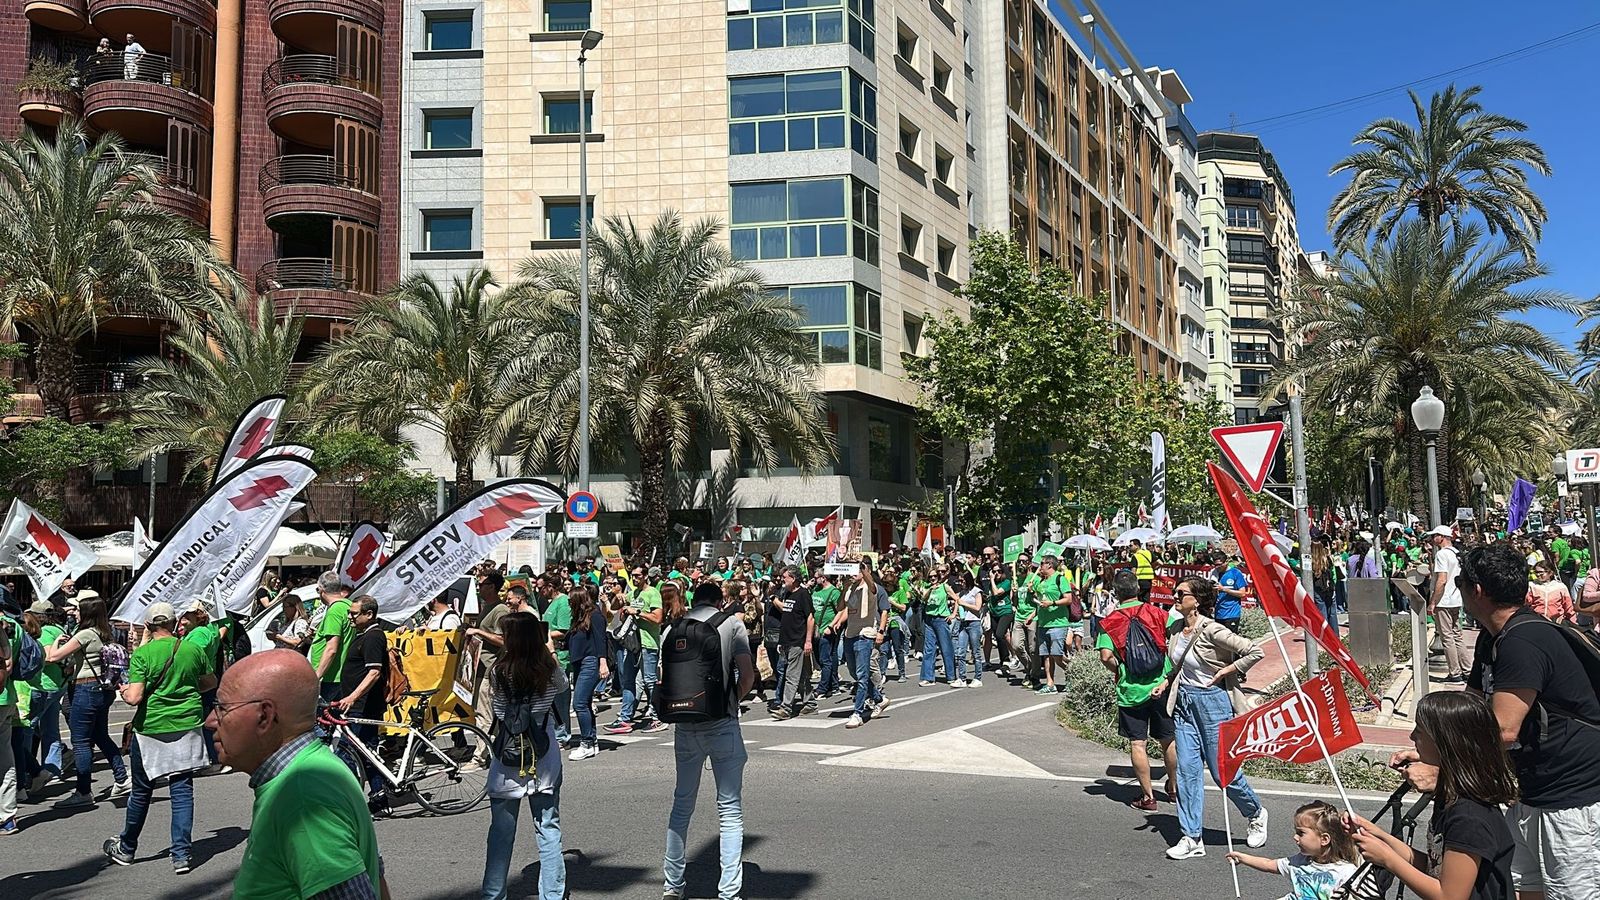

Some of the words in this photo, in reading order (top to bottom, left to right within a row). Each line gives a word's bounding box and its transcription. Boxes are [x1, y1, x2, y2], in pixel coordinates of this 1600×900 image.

[138, 519, 231, 607] INTERSINDICAL
[221, 547, 258, 606] ALENCIANA
[395, 523, 462, 586] STEPV
[409, 542, 473, 593] INTERSINDICAL
[423, 550, 479, 595] VALENCIANA
[1154, 567, 1176, 578] VEU
[160, 567, 197, 604] LENCIANA
[1246, 695, 1302, 745] UGT
[1319, 671, 1343, 738] www.ugt.e
